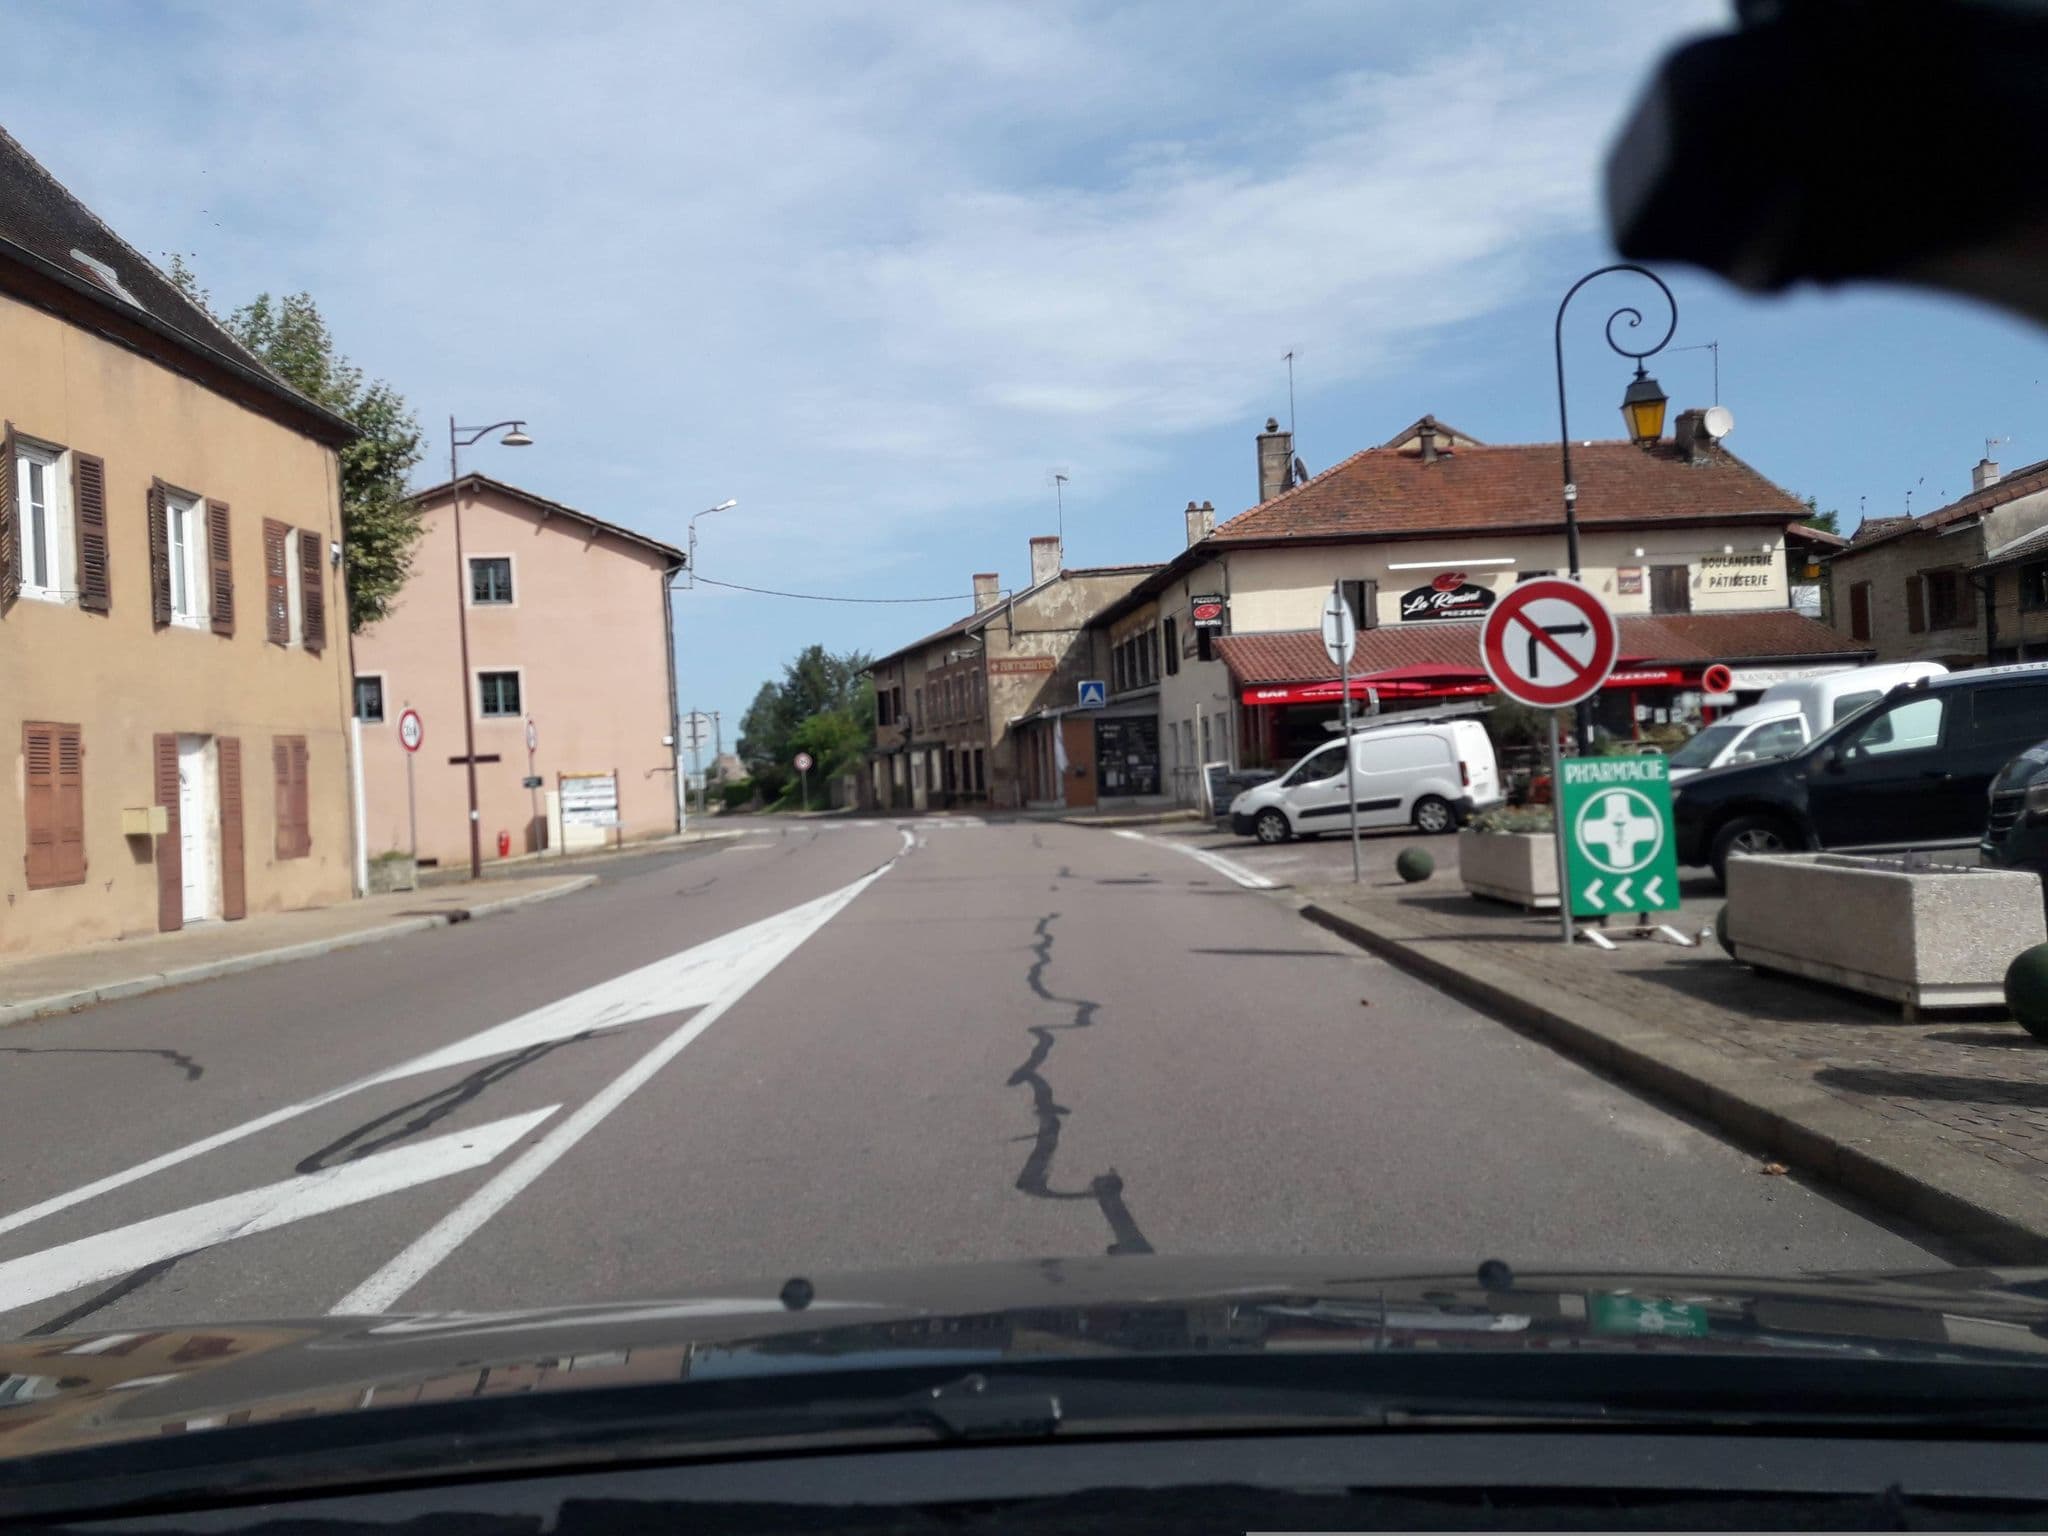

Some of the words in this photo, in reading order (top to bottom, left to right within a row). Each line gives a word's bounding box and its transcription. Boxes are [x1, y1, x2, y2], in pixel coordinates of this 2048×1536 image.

[1701, 555, 1773, 568] BOULANGERIE
[1403, 595, 1429, 615] La
[1257, 690, 1288, 699] BAR
[1564, 759, 1666, 785] PHARMACIE
